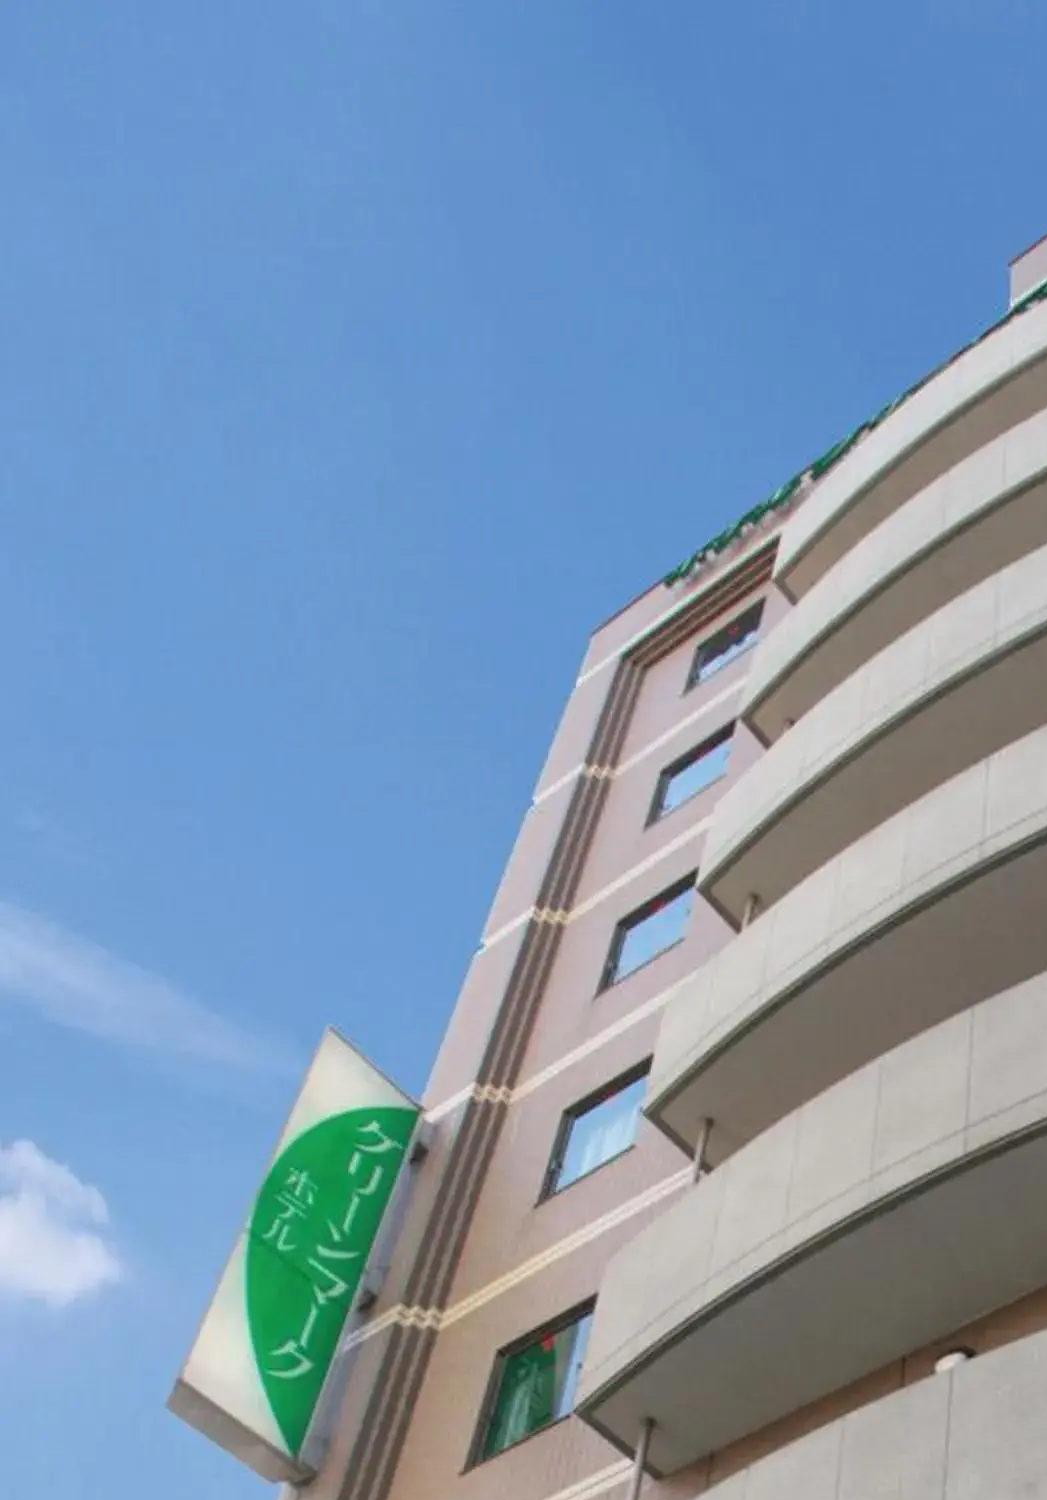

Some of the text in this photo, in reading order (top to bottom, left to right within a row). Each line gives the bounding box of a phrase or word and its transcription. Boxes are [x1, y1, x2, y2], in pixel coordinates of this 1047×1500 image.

[263, 1167, 318, 1252] ホテル
[267, 1120, 405, 1379] グリーンマーク
